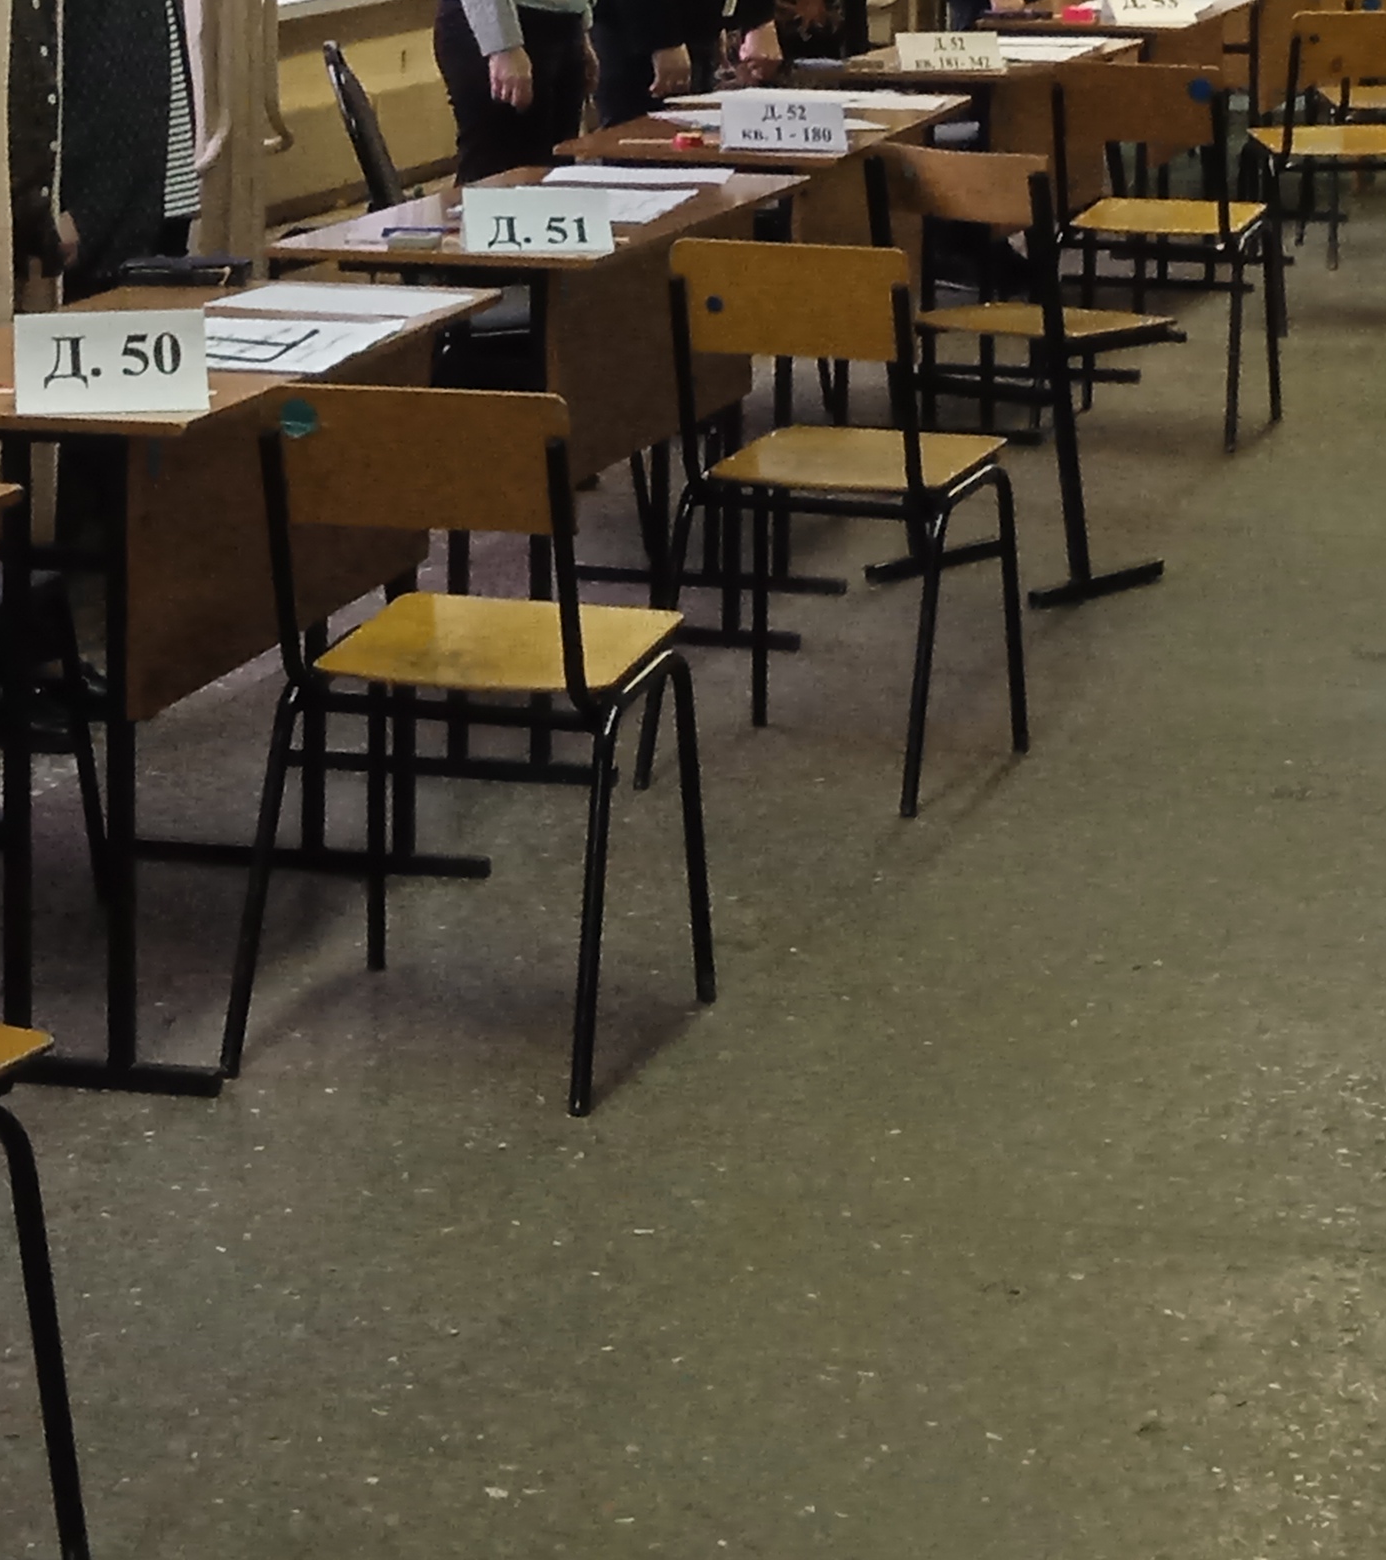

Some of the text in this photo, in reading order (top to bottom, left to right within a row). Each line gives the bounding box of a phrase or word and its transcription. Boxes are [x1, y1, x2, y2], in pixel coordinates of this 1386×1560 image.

[761, 104, 807, 122] Д. 52
[741, 128, 769, 141] кв.
[775, 127, 783, 141] 1
[803, 127, 832, 142] 180
[487, 215, 589, 251] Д. 51
[44, 331, 181, 389] Д. 50
